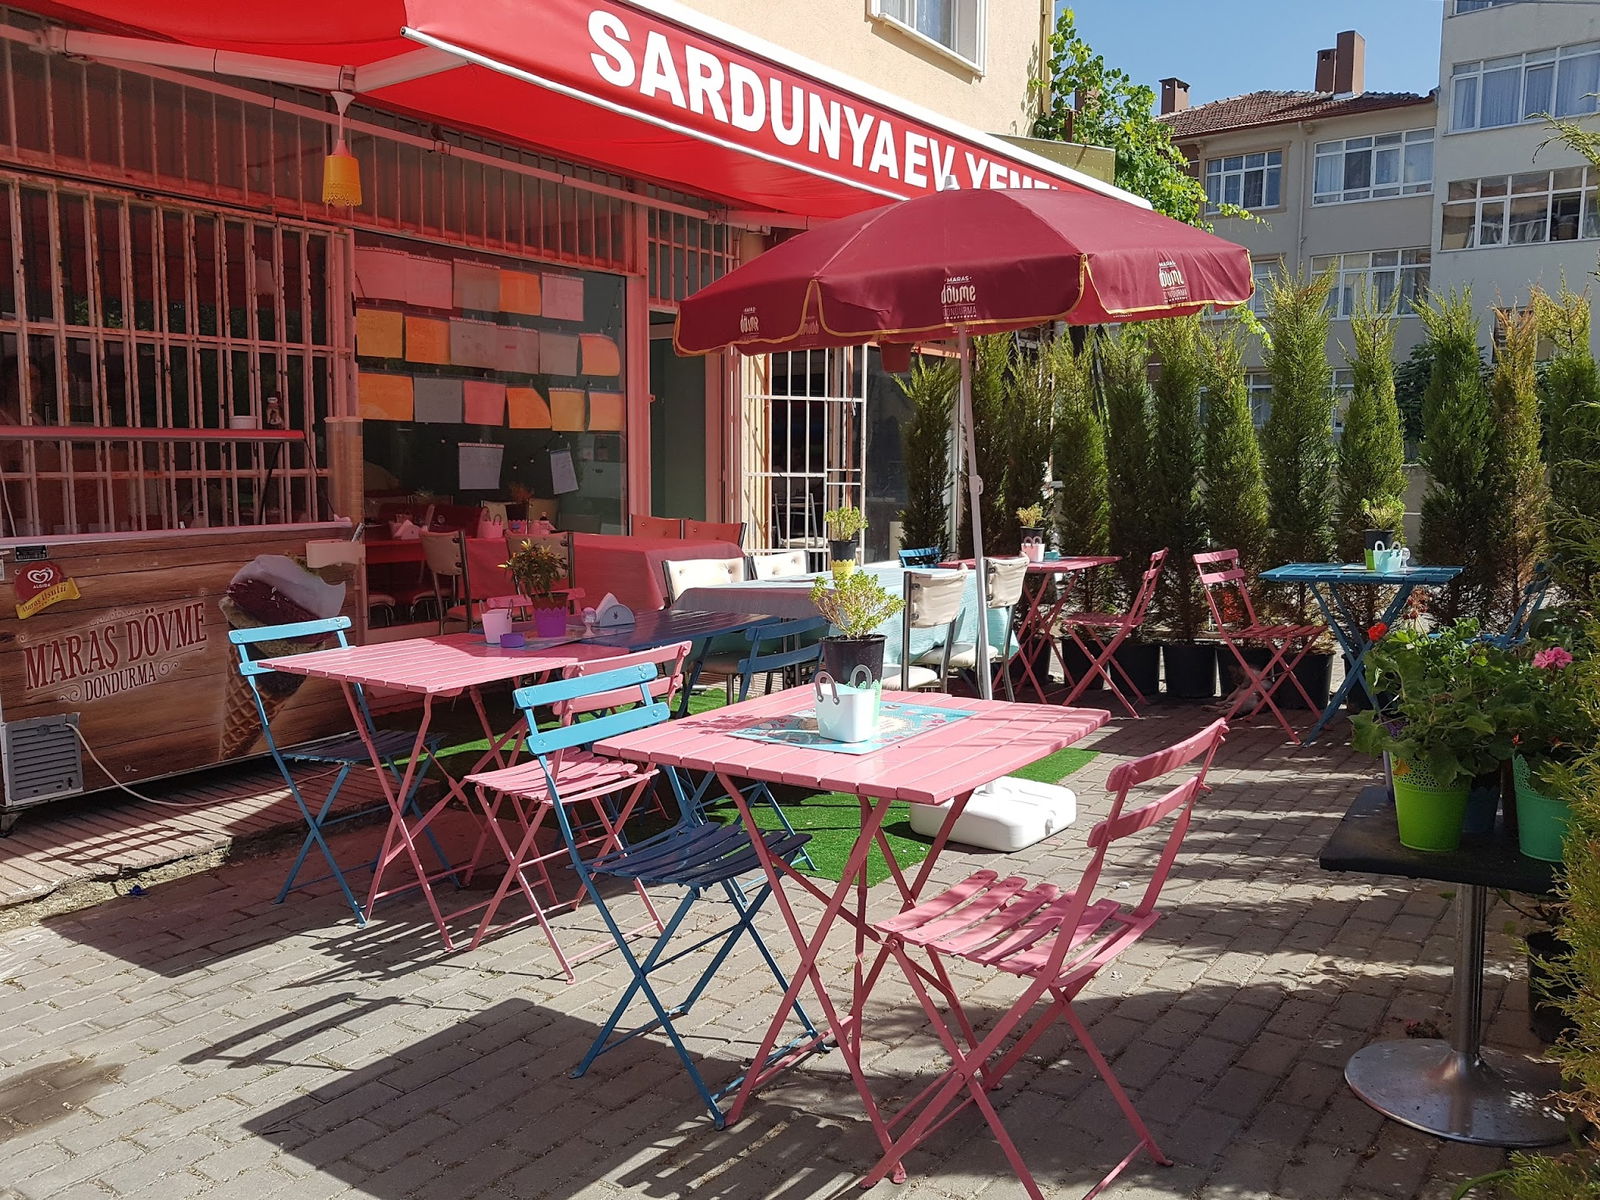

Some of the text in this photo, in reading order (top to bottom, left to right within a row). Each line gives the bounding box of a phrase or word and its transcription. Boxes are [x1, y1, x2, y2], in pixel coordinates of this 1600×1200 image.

[23, 602, 207, 690] MARAŞ DÖVME
[85, 662, 156, 701] DONDURMA
